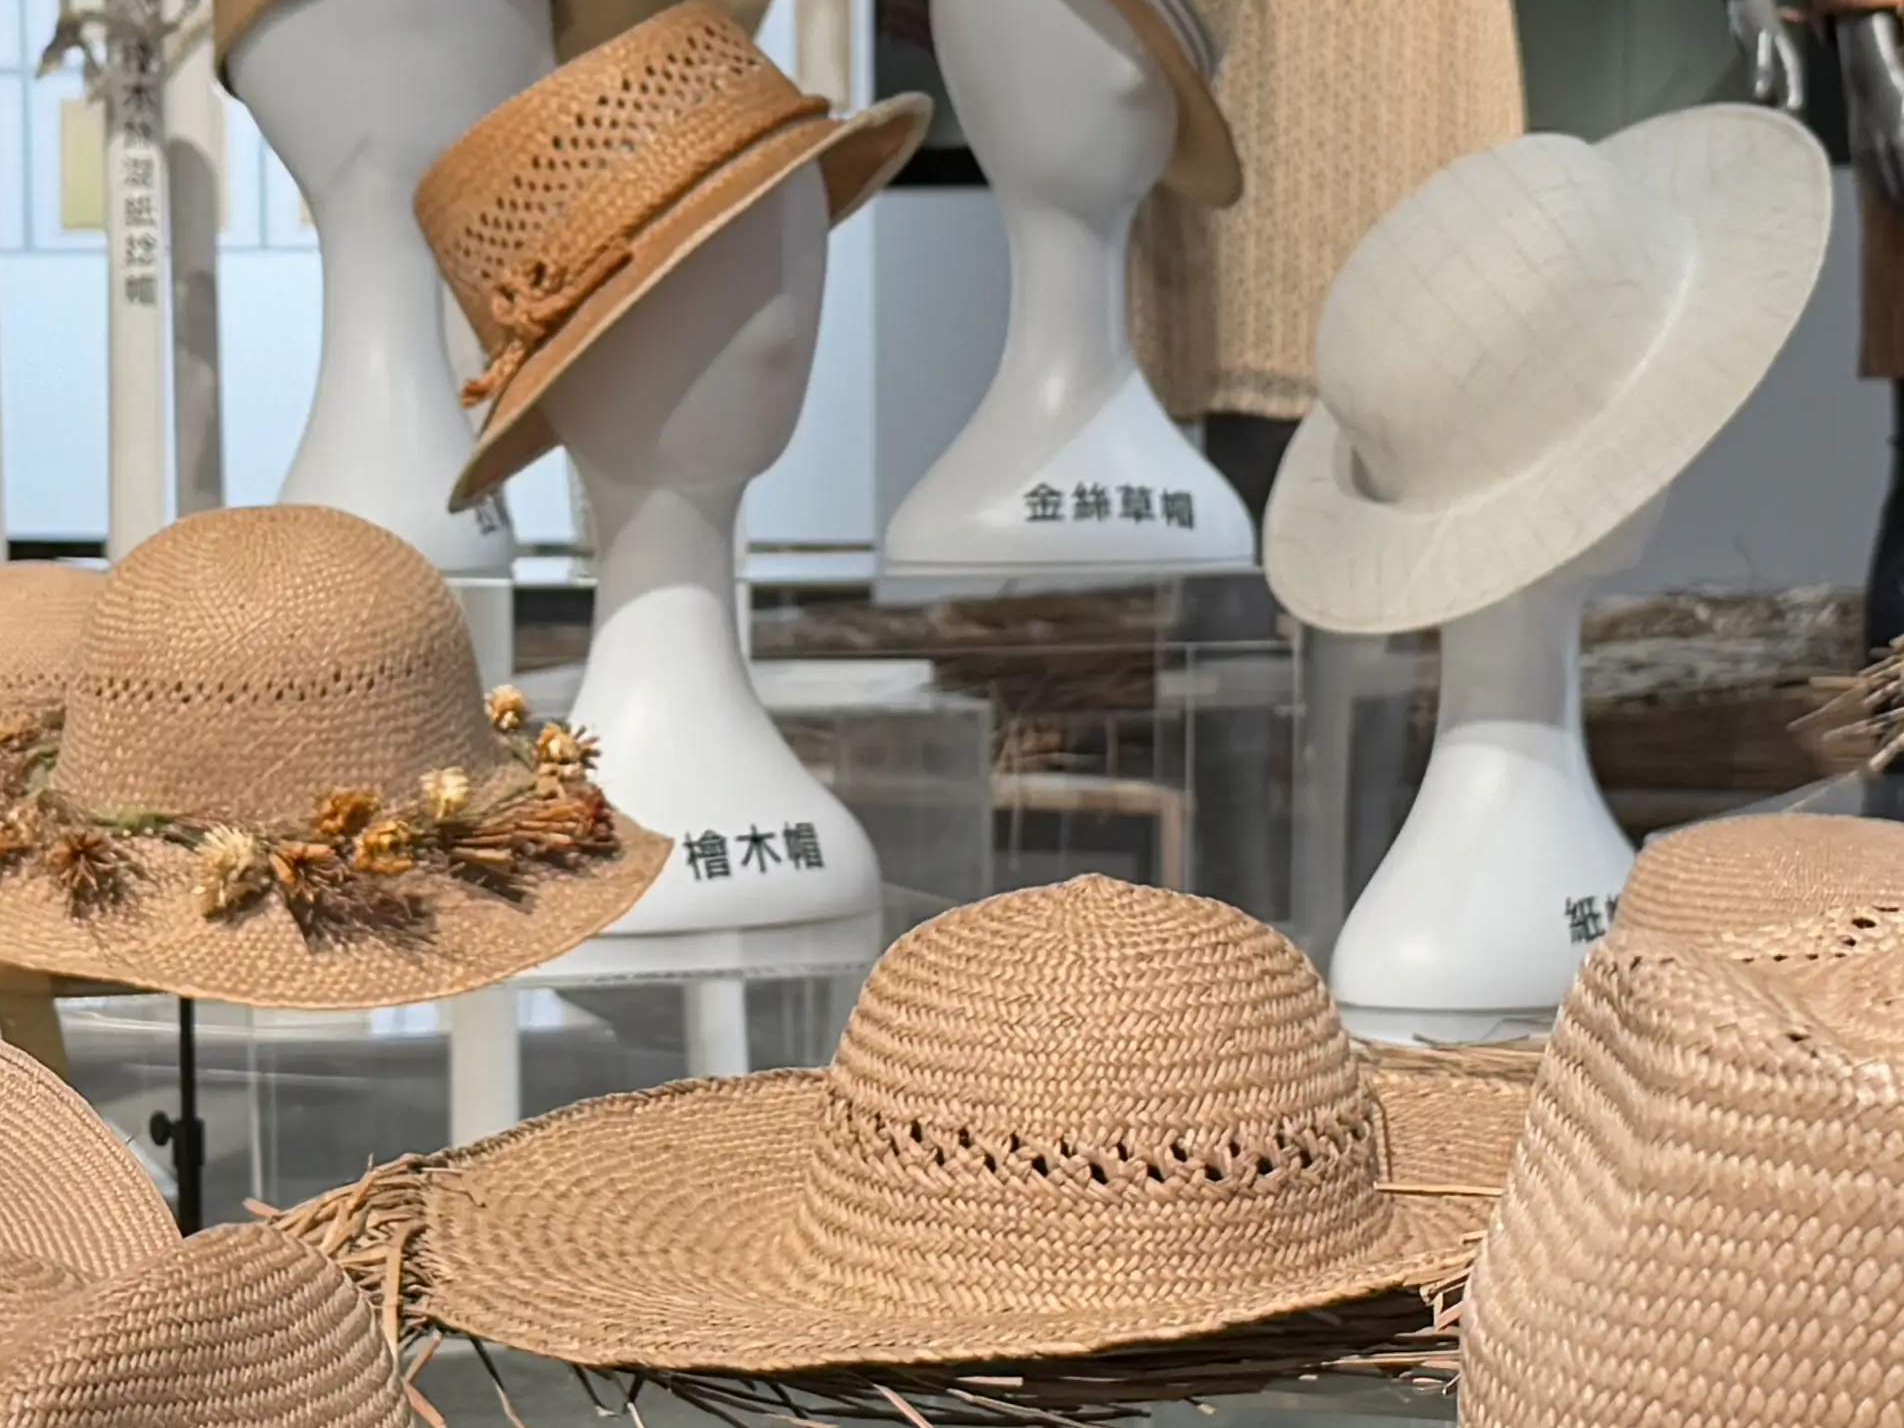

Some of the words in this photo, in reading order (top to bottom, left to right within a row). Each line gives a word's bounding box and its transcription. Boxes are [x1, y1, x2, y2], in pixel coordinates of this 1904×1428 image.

[1024, 481, 1195, 532] 金絲草帽
[683, 821, 826, 881] 檜木帽
[1564, 892, 1622, 945] 紙
